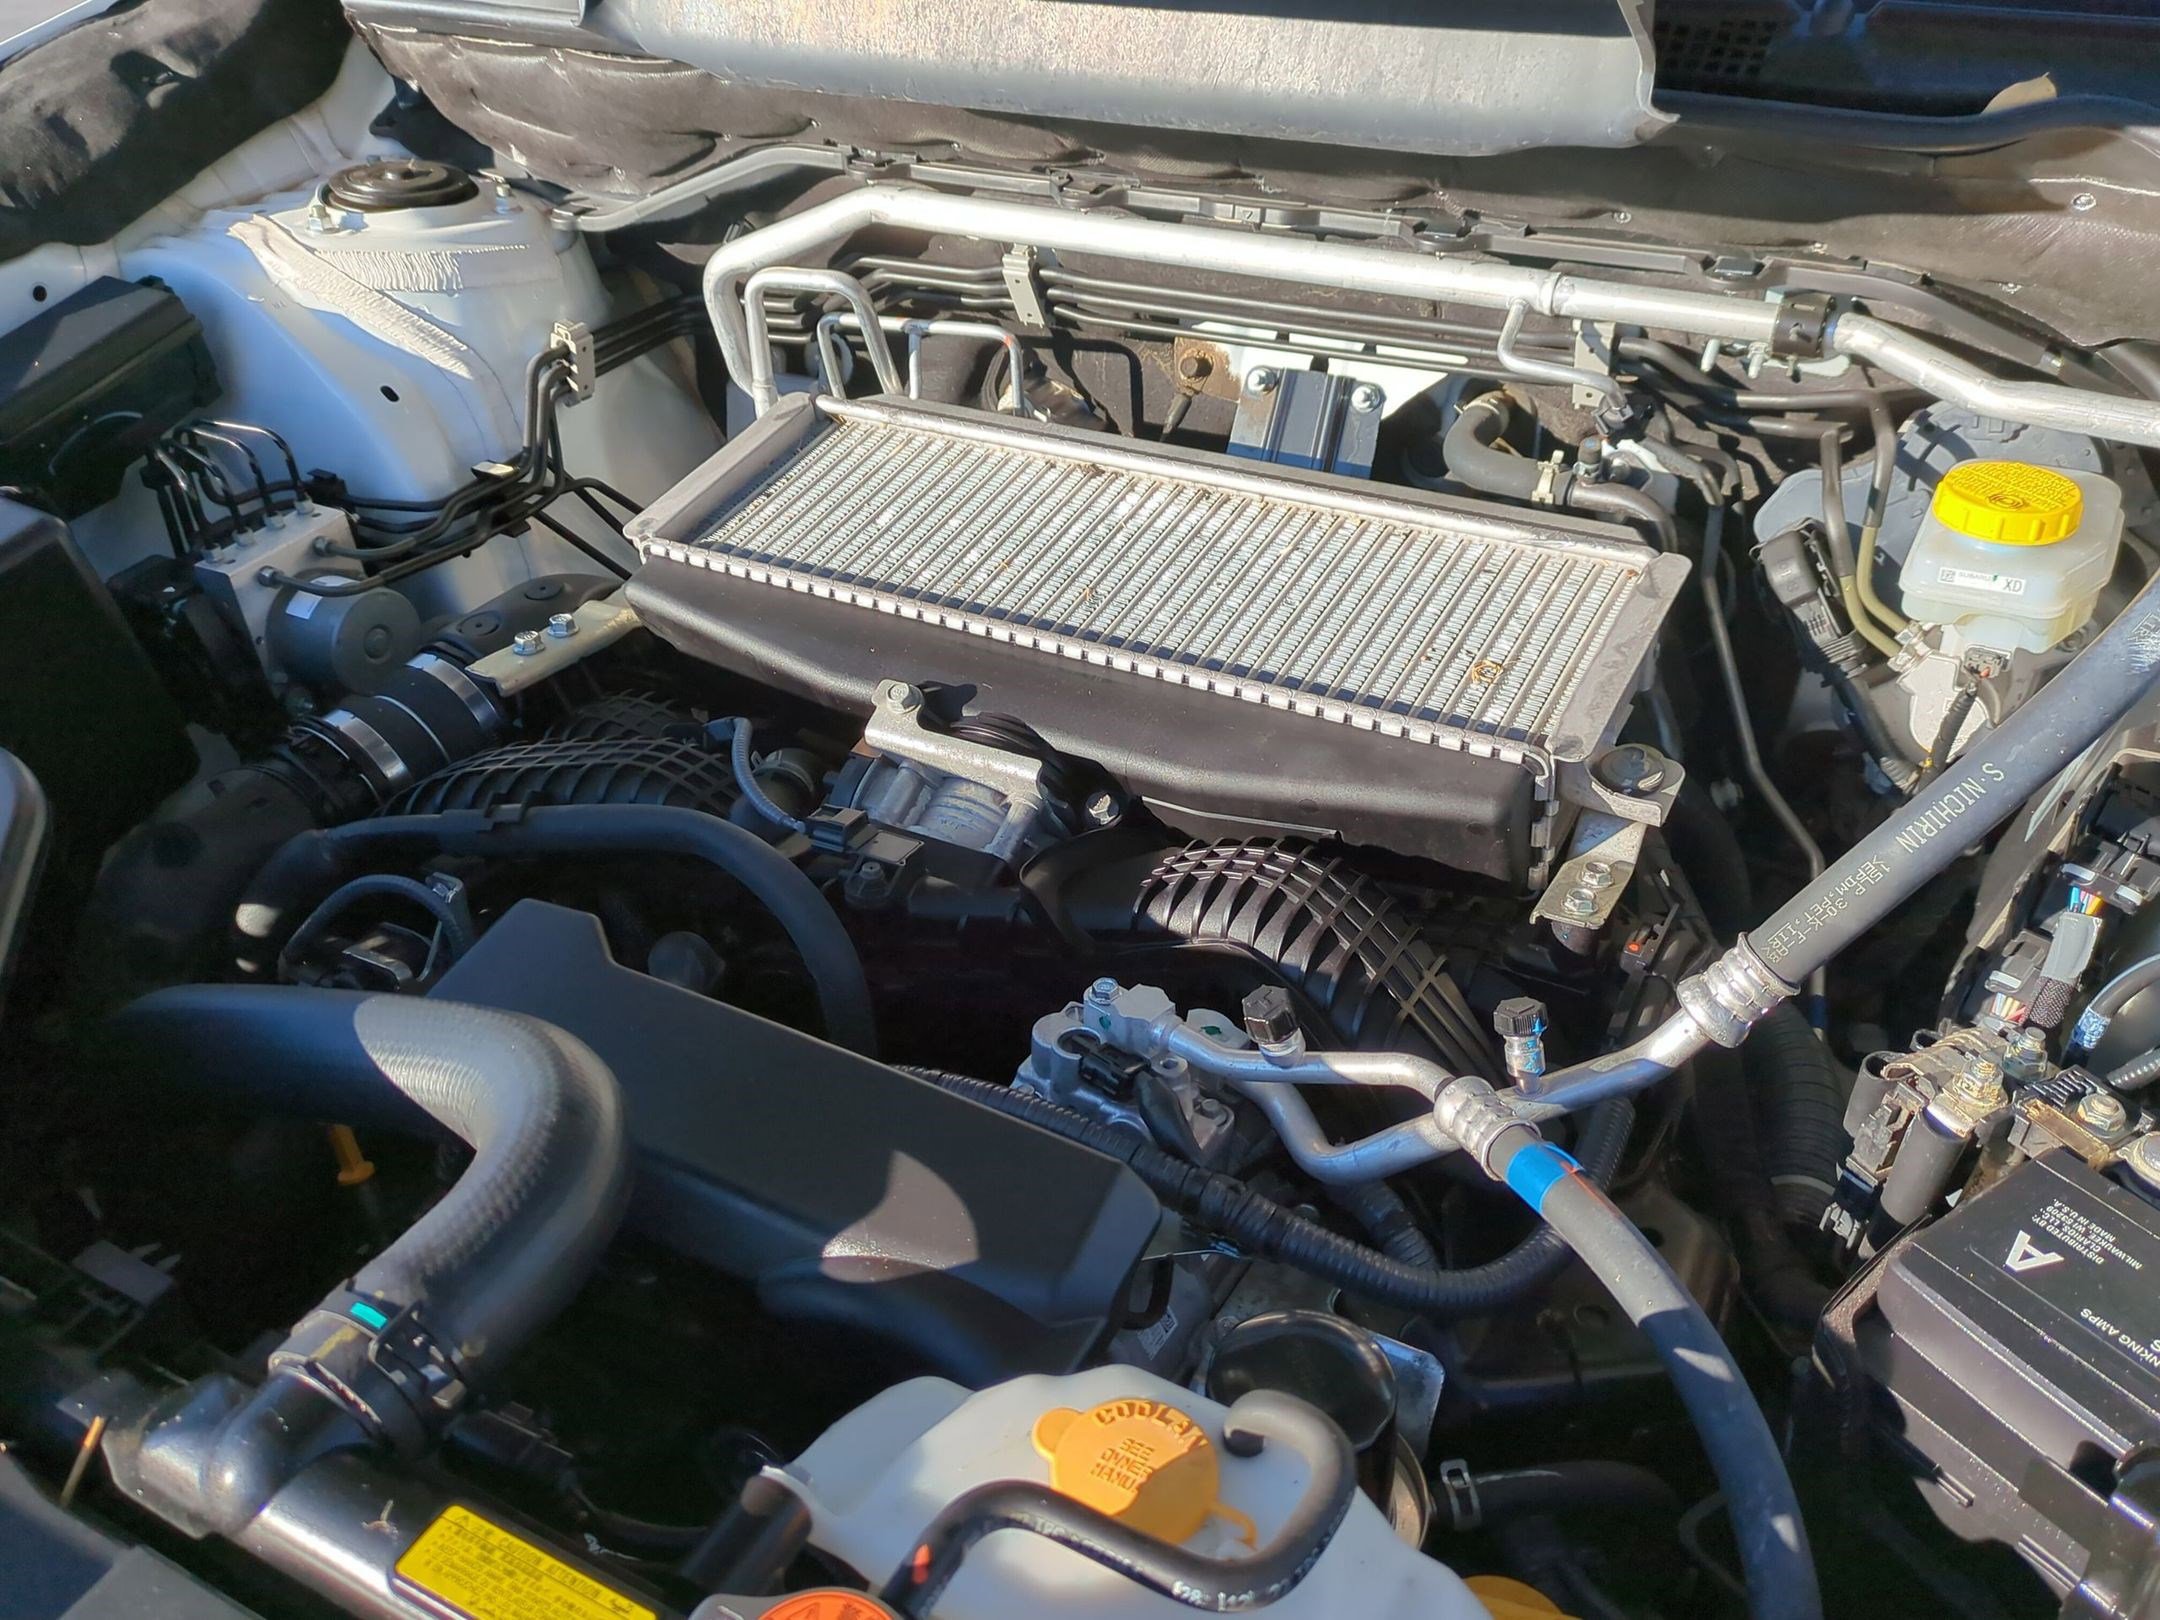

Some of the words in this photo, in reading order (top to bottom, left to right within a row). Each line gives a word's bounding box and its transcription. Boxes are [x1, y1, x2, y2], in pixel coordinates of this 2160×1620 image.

[2002, 578, 2022, 593] XD
[1855, 861, 1891, 897] 15LP
[2032, 1215, 2046, 1226] BY:
[2047, 1207, 2073, 1224] 53209
[2054, 1199, 2078, 1218] U.S.A.
[2078, 1217, 2089, 1225] IN
[2073, 1223, 2085, 1233] WI
[2088, 1224, 2115, 1242] MADE
[2006, 1231, 2064, 1271] A
[2047, 1221, 2103, 1263] DISTRIBUTED
[2081, 1309, 2119, 1334] AMPS
[1093, 1402, 1208, 1451] COOLAN
[1120, 1437, 1156, 1462] SEE
[1089, 1462, 1139, 1492] MANU
[498, 1536, 543, 1567] CAUTION
